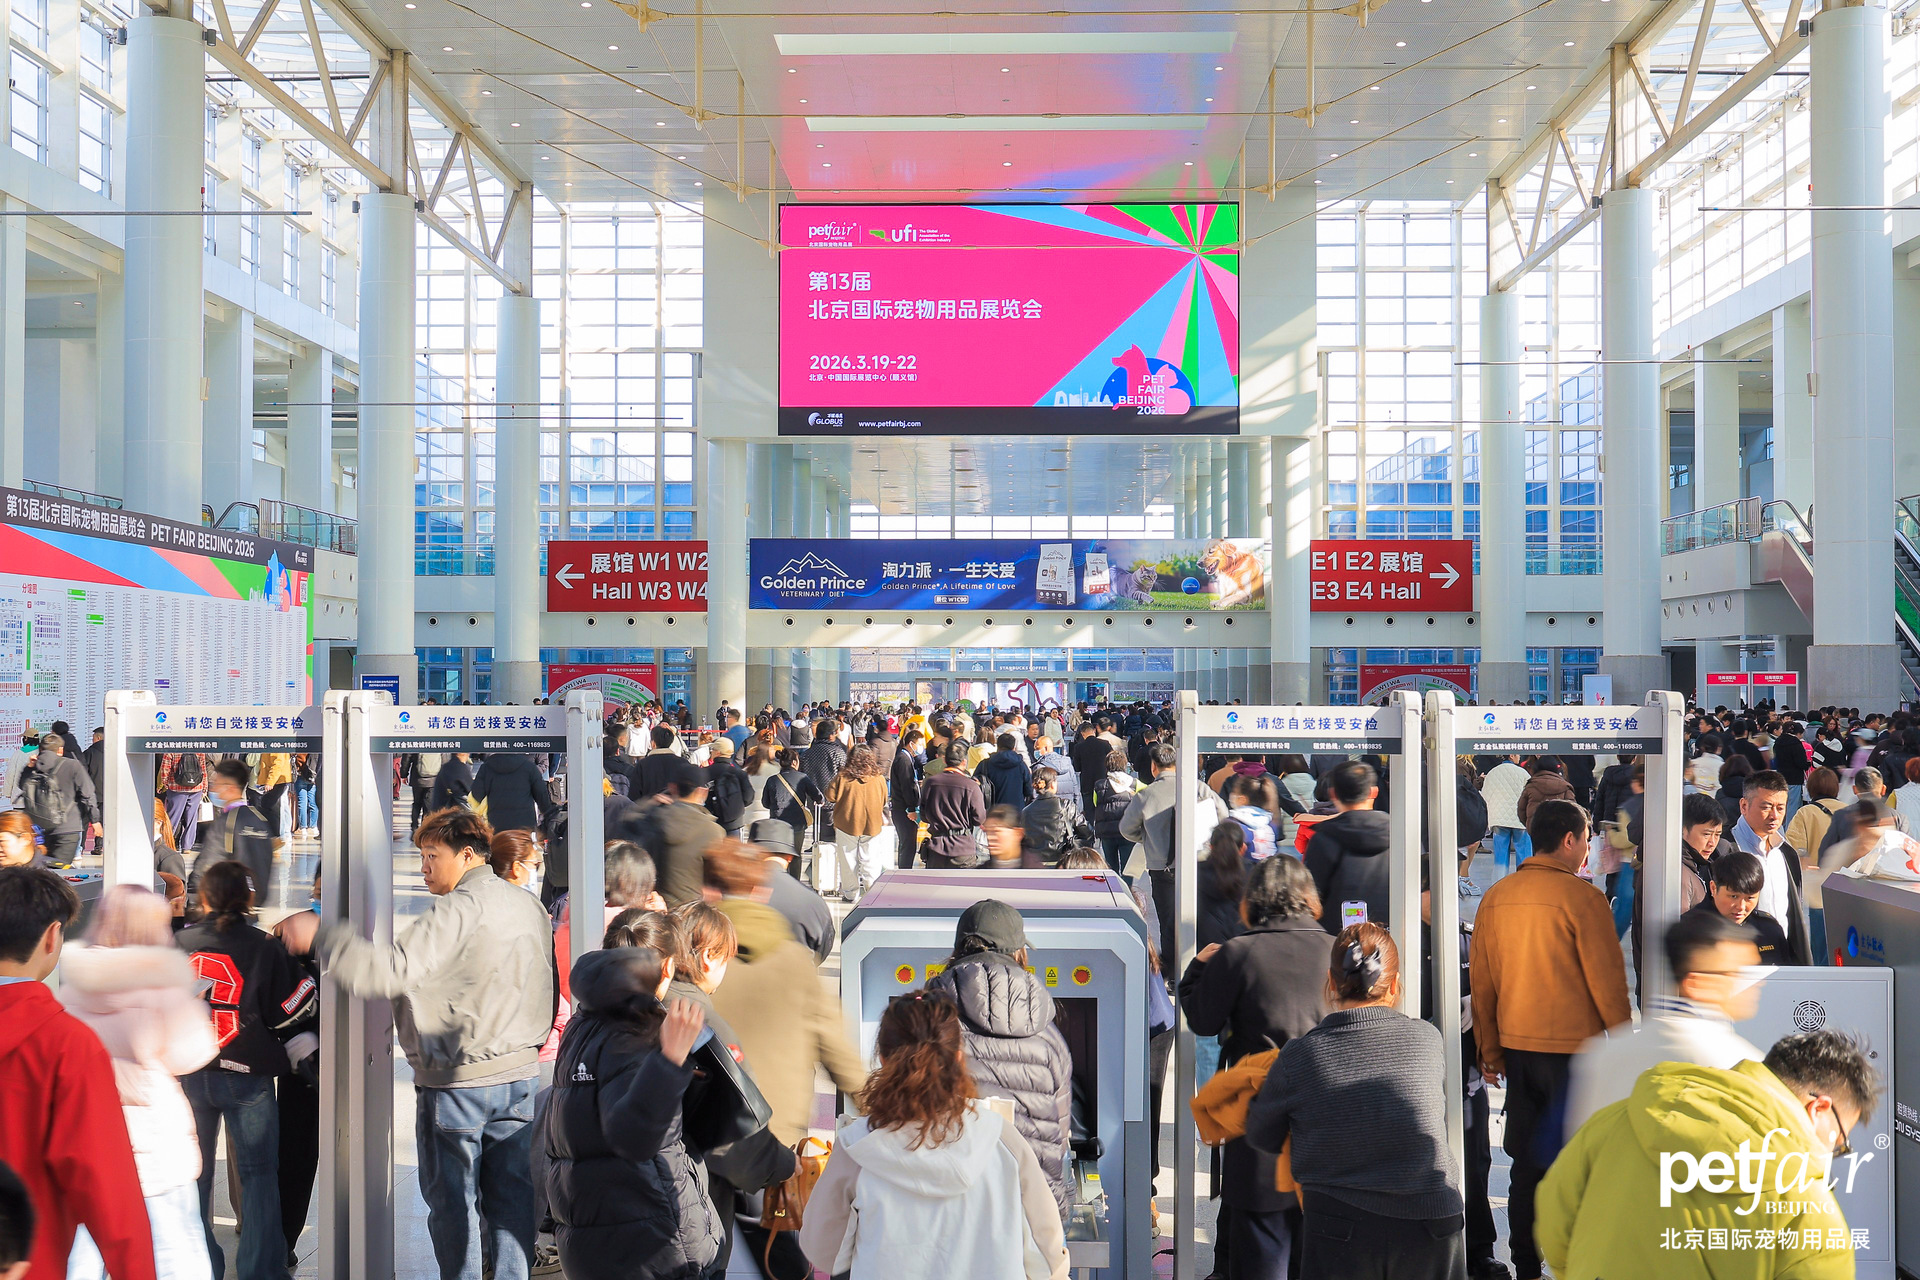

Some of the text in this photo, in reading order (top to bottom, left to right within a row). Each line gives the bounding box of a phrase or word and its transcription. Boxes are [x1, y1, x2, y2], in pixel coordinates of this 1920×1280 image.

[892, 224, 917, 242] ufi
[808, 271, 871, 291] 第13届
[808, 299, 1042, 320] 北京国际宠物用品展览会
[810, 355, 917, 370] 2026.3.19-22
[1143, 375, 1165, 383] PET
[1138, 385, 1165, 394] FAIR
[1118, 396, 1165, 404] BEIJING
[1137, 406, 1165, 415] 2026
[858, 420, 922, 428] www.petfairbj.com
[6, 494, 146, 539] 第13届北京国际宠物用品展览会
[151, 523, 255, 558] PET FAIR BEIJING 2026
[590, 552, 708, 573] 展馆 W1 W2
[1312, 552, 1423, 572] E1 E2 展馆
[882, 562, 1016, 579] 淘力派·一生关爱
[760, 575, 866, 590] Golden Prince
[592, 582, 708, 600] Hall W3 W4
[1312, 581, 1421, 600] E3 E4 Hall
[184, 717, 304, 730] 请您自觉接受安检
[428, 716, 547, 729] 请您自觉接受安检
[1256, 717, 1378, 731] 请您自觉接受安检
[1514, 717, 1638, 731] 请您自觉接受安检
